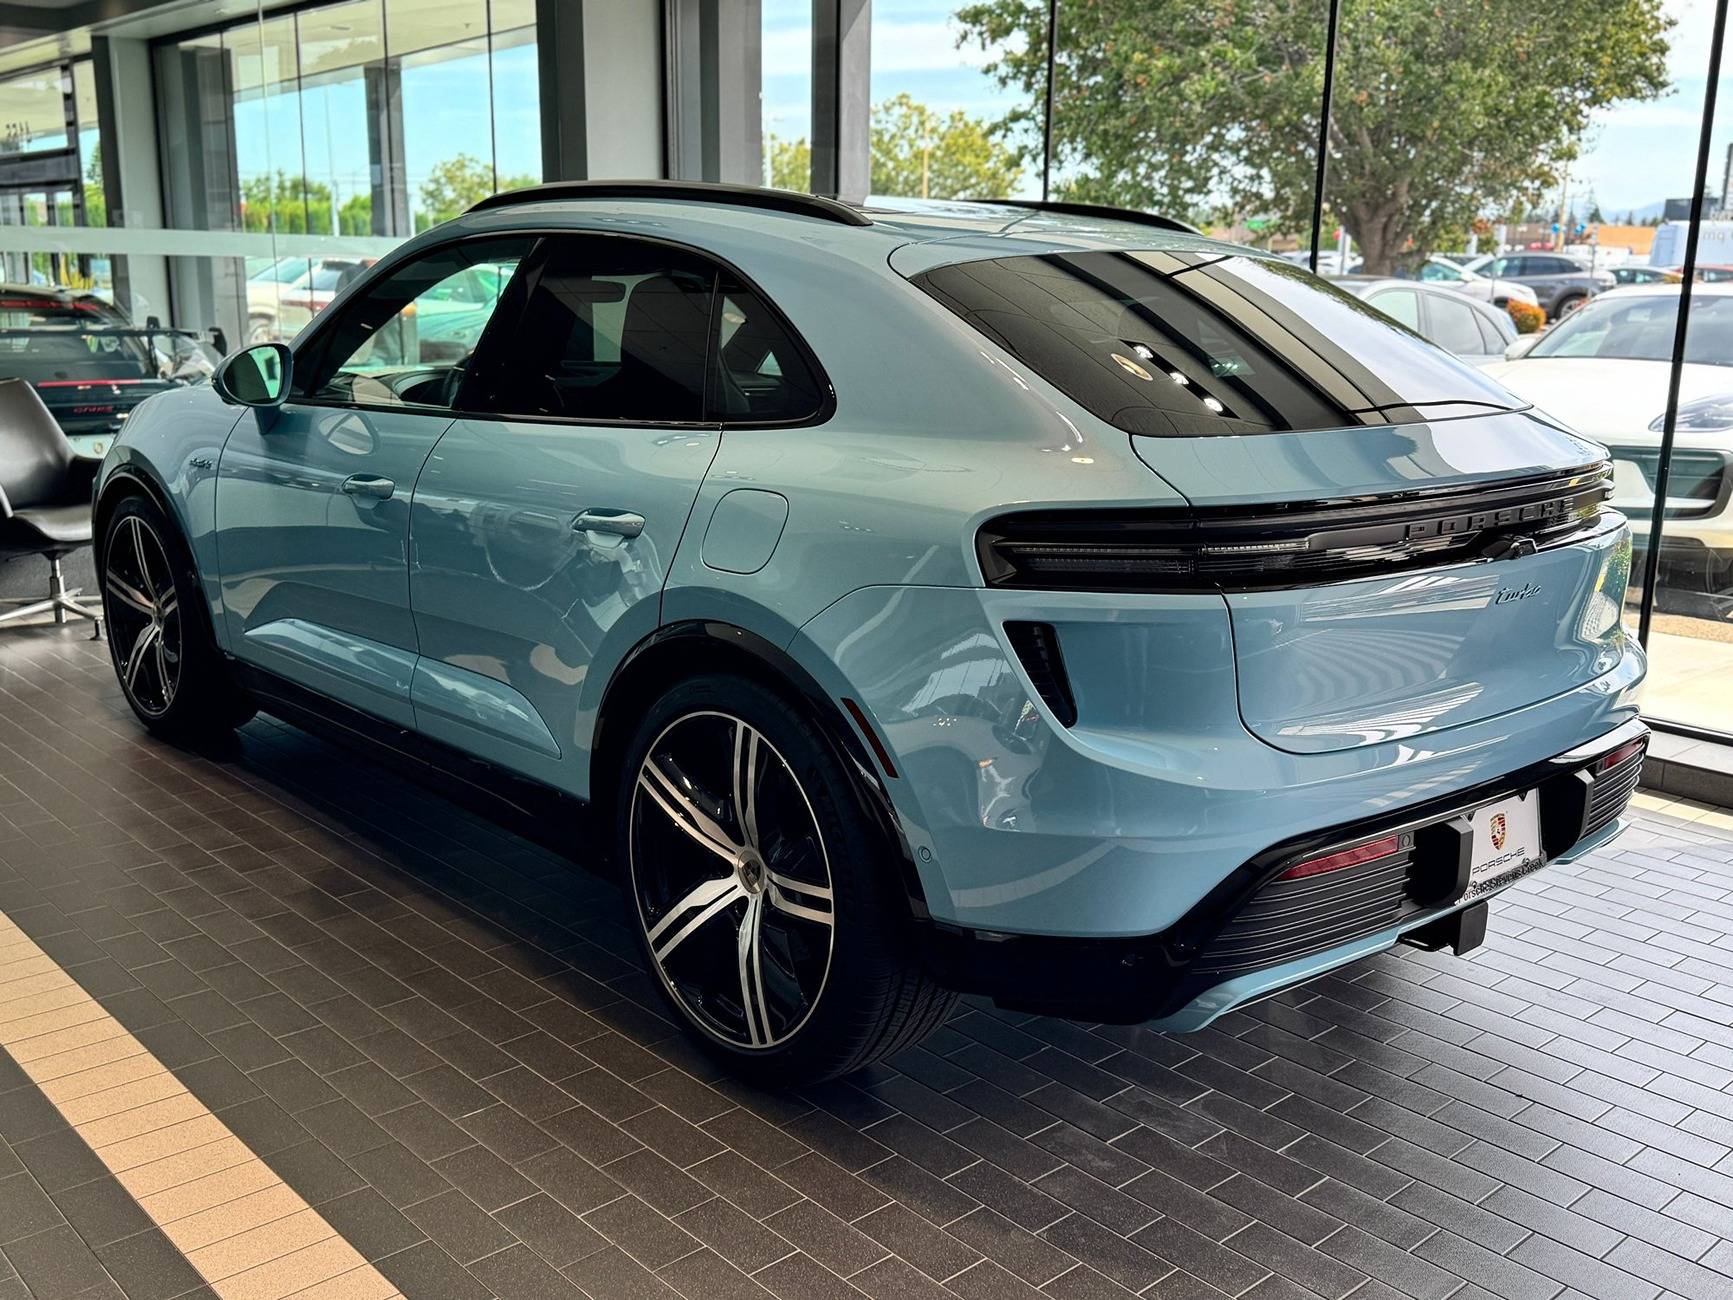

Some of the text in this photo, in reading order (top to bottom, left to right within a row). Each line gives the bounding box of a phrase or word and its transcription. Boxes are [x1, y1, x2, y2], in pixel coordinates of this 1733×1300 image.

[1405, 498, 1574, 539] PORSCHE
[1495, 583, 1541, 604] turbo
[1472, 847, 1525, 875] PORSCHE
